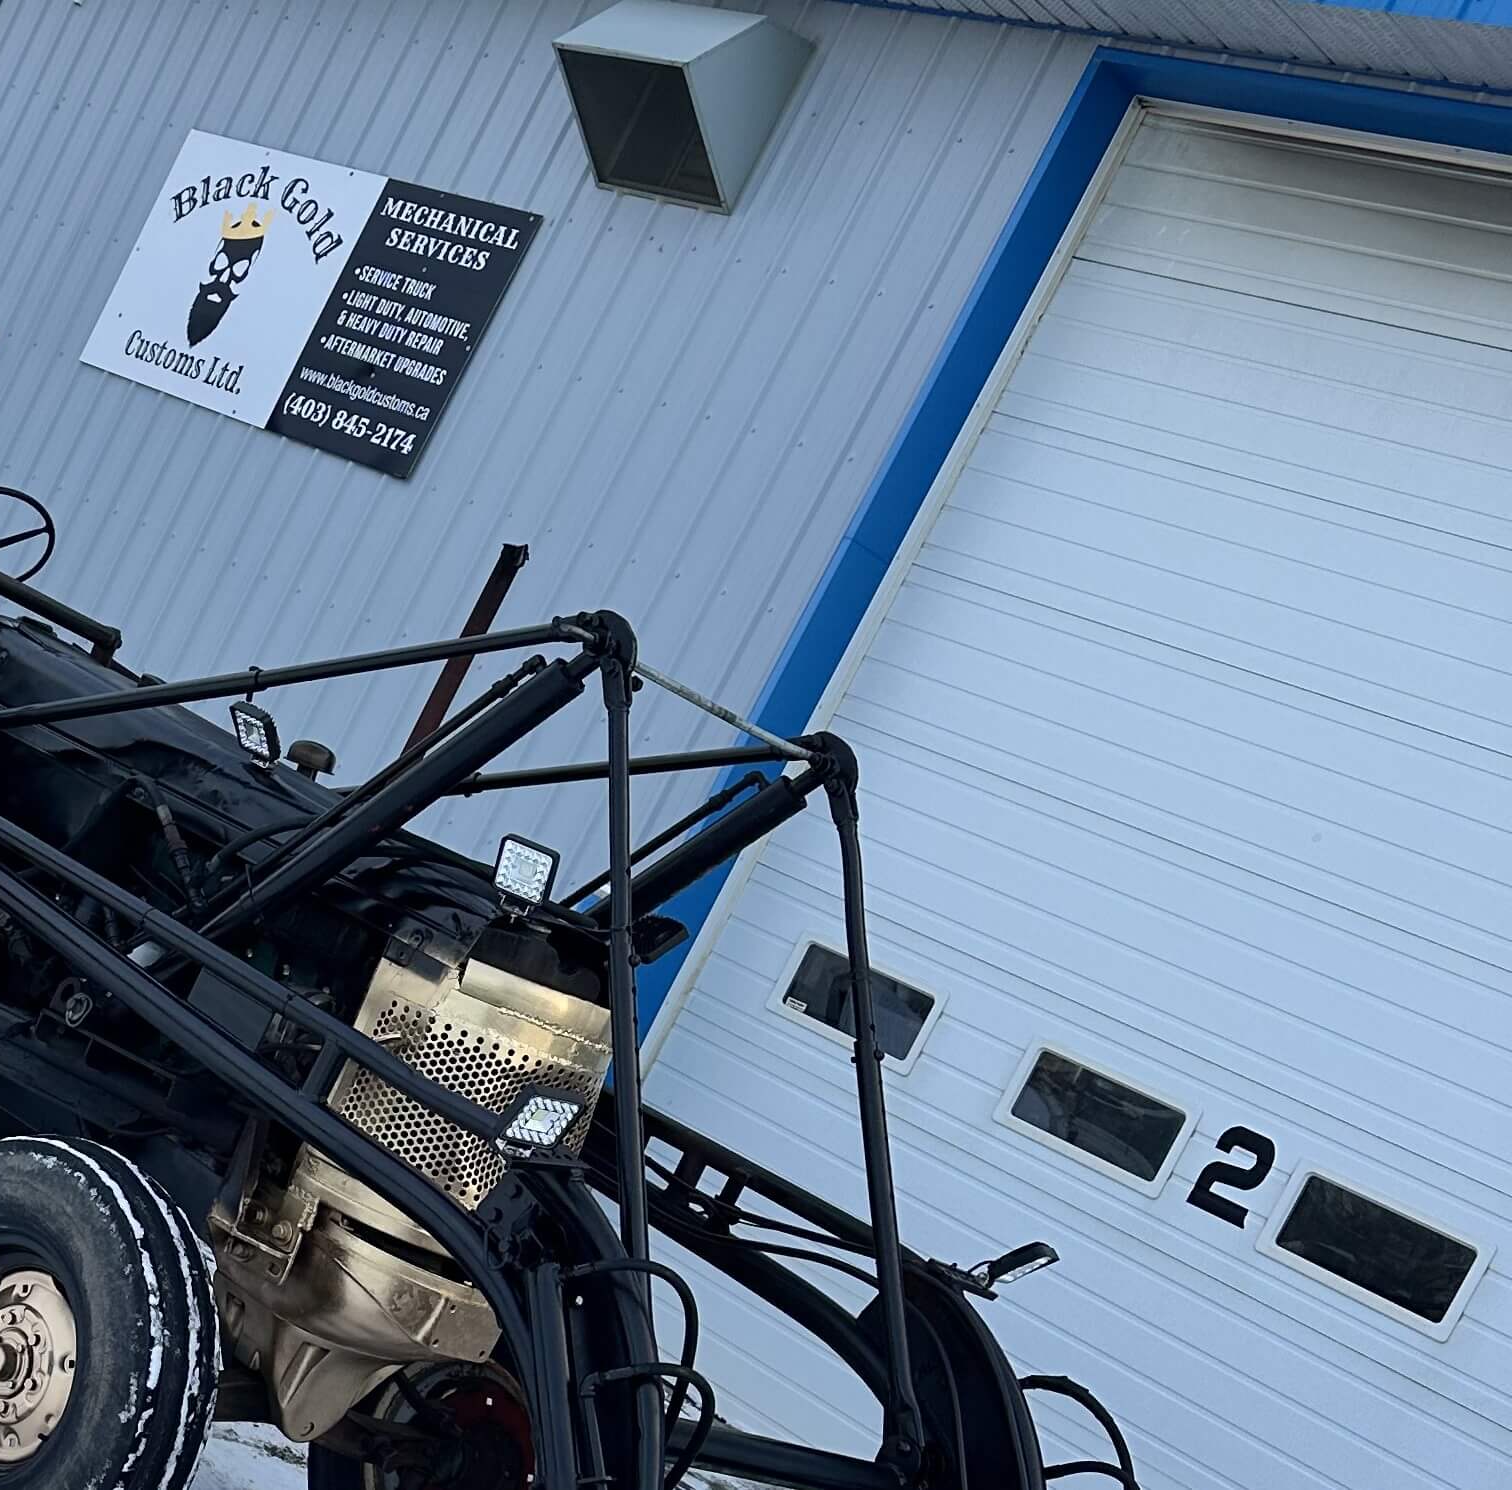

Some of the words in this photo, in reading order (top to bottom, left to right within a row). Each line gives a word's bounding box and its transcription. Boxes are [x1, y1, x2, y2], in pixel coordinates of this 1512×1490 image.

[170, 166, 279, 223] Black
[281, 178, 343, 264] Gold
[380, 197, 520, 250] MECHANICAL
[385, 228, 490, 271] SERVICES
[359, 265, 402, 290] SERVICE
[400, 277, 437, 301] TRUCK
[336, 310, 348, 325] &
[345, 312, 379, 337] HEAVY
[377, 322, 407, 344] DUTY
[404, 330, 445, 356] REPAIR
[346, 289, 378, 311] LIGHT
[375, 298, 406, 322] DUTY,
[404, 307, 470, 342] AUTOMOTIVE,
[124, 329, 206, 379] Customs
[203, 356, 244, 395] Ltd.
[323, 334, 395, 374] AFTERMARKET
[393, 354, 448, 386] UPGRADES
[299, 366, 431, 421] www.blackgoldcustoms.ca
[283, 392, 332, 428] (403)
[331, 409, 417, 456] 845-2174
[1186, 1126, 1276, 1229] 2
